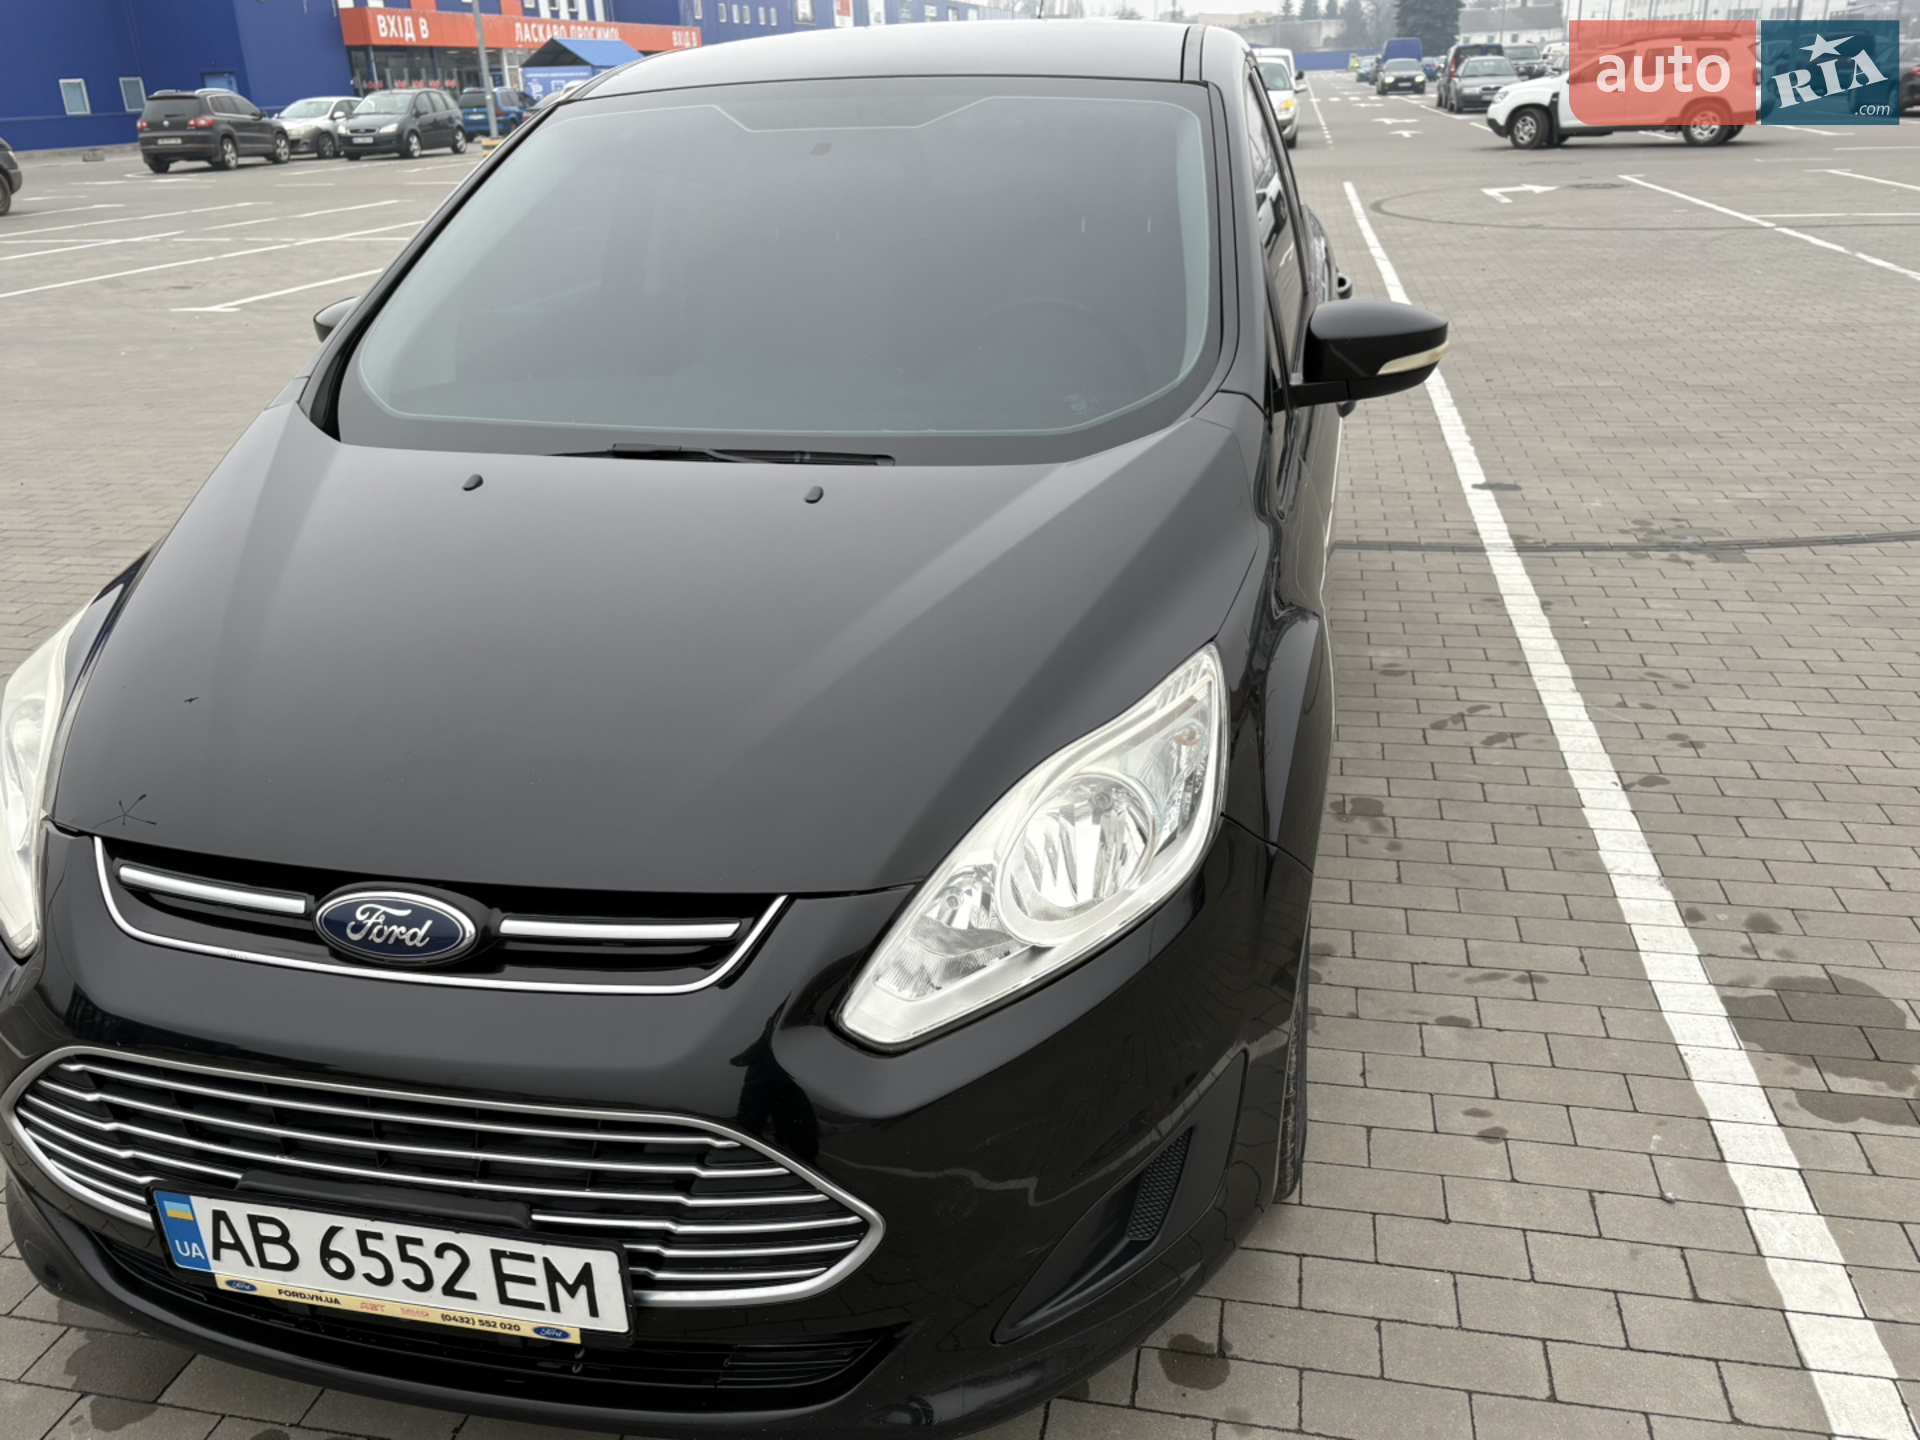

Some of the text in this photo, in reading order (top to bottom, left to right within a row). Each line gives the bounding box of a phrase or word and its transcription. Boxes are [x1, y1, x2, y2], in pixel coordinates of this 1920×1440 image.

[376, 14, 417, 43] ВХІД
[514, 22, 568, 43] ЛАСКАВО
[346, 903, 434, 948] Ford
[174, 1239, 206, 1261] UA
[210, 1208, 600, 1318] AB 6552 EM
[277, 1288, 341, 1306] FORD.VN.UA
[440, 1312, 476, 1327] (0432)
[477, 1318, 498, 1329] 552
[499, 1321, 521, 1332] 020
